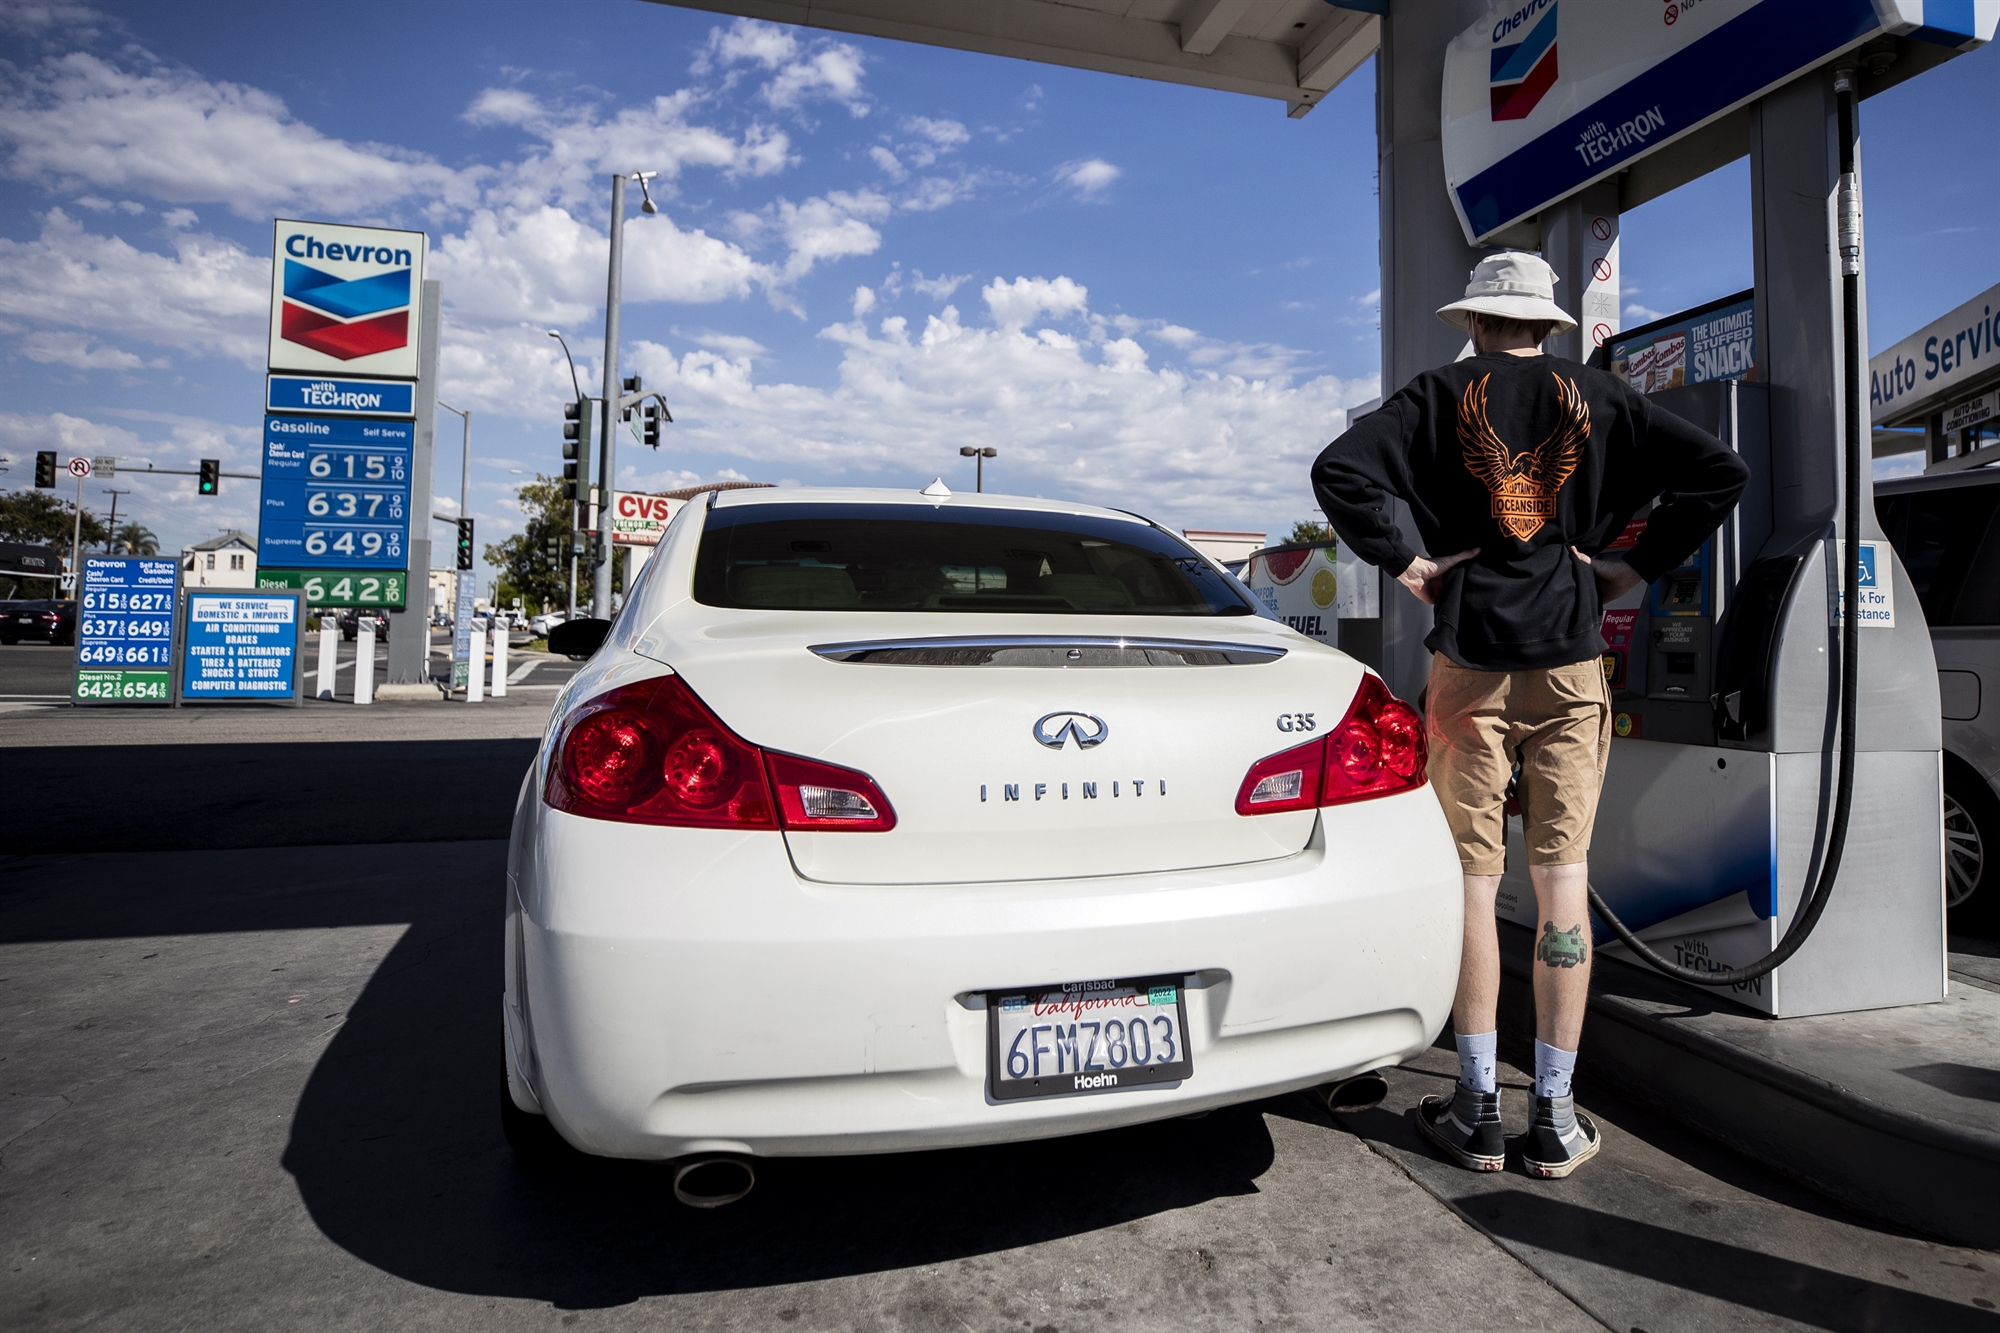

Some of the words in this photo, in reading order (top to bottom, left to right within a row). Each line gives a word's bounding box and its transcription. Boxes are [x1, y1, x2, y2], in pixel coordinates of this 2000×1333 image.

[1575, 106, 1666, 167] TECHRON
[1580, 121, 1607, 144] with
[285, 234, 411, 266] Chevron
[1692, 323, 1708, 341] THE
[1709, 309, 1753, 336] ULTIMATE
[1693, 326, 1753, 353] STUFFED
[1655, 338, 1685, 364] Combos
[1629, 346, 1655, 373] Combos
[1693, 337, 1755, 383] SNACK
[311, 381, 336, 392] with
[1870, 355, 1915, 410] Auto
[301, 387, 381, 410] TECHRON
[1953, 398, 1983, 419] AUTO-AIR
[269, 420, 330, 435] Gasoline
[1946, 407, 1990, 432] CONDITIONING
[363, 427, 380, 437] Self
[381, 428, 406, 438] Serve
[268, 450, 290, 458] Chevron
[291, 451, 305, 459] Card
[268, 458, 301, 467] Regular
[309, 453, 385, 479] 615
[266, 499, 285, 507] Plus
[307, 492, 383, 518] 637
[618, 495, 668, 521] CVS
[1496, 499, 1551, 513] OCEANSIDE
[615, 520, 647, 528] FREMONT
[1510, 517, 1537, 533] GROUNDS
[264, 537, 302, 546] Supreme
[305, 531, 382, 556] 649
[87, 559, 126, 569] Chevron
[154, 562, 174, 570] Serve
[110, 576, 124, 584] Card
[138, 576, 174, 584] Credit/Debit
[259, 578, 288, 589] Diesel
[304, 577, 380, 602] 642
[1263, 586, 1274, 599] FOR
[83, 593, 119, 610] 615
[129, 593, 164, 610] 627
[219, 601, 232, 610] WE
[235, 602, 269, 610] SERVICE
[1868, 592, 1885, 604] For
[197, 610, 240, 619] DOMESTIC
[252, 611, 288, 620] IMPORTS
[1605, 614, 1635, 625] Regular
[1833, 607, 1891, 620] Asstance
[82, 620, 118, 636] 637
[127, 620, 163, 637] 649
[205, 623, 220, 633] AIR
[222, 624, 280, 634] CONDITIONING
[225, 635, 258, 645] BRAKES
[80, 646, 116, 663] 649
[126, 646, 158, 663] 661
[190, 646, 225, 656] STARTER
[228, 646, 234, 656] &
[237, 646, 291, 657] ALTERNATORS
[200, 658, 225, 667] TIRES
[227, 658, 234, 667] &
[237, 658, 282, 668] BATTERIES
[201, 668, 234, 678] SHOCKS
[237, 668, 244, 678] &
[247, 668, 279, 678] STRUTS
[77, 682, 114, 698] 642
[123, 682, 158, 698] 654
[191, 680, 236, 690] COMPUTER
[238, 681, 287, 691] DIAGNOSTIC
[1276, 712, 1317, 734] G35
[980, 778, 1166, 802] INFINITI
[1683, 938, 1708, 957] with
[1062, 979, 1116, 993] Carlsbad
[1002, 999, 1030, 1012] SEP
[1034, 992, 1150, 1021] California
[1153, 988, 1171, 997] 2022
[1007, 1015, 1176, 1079] 6FMZ803
[1074, 1073, 1118, 1090] Hoehn
